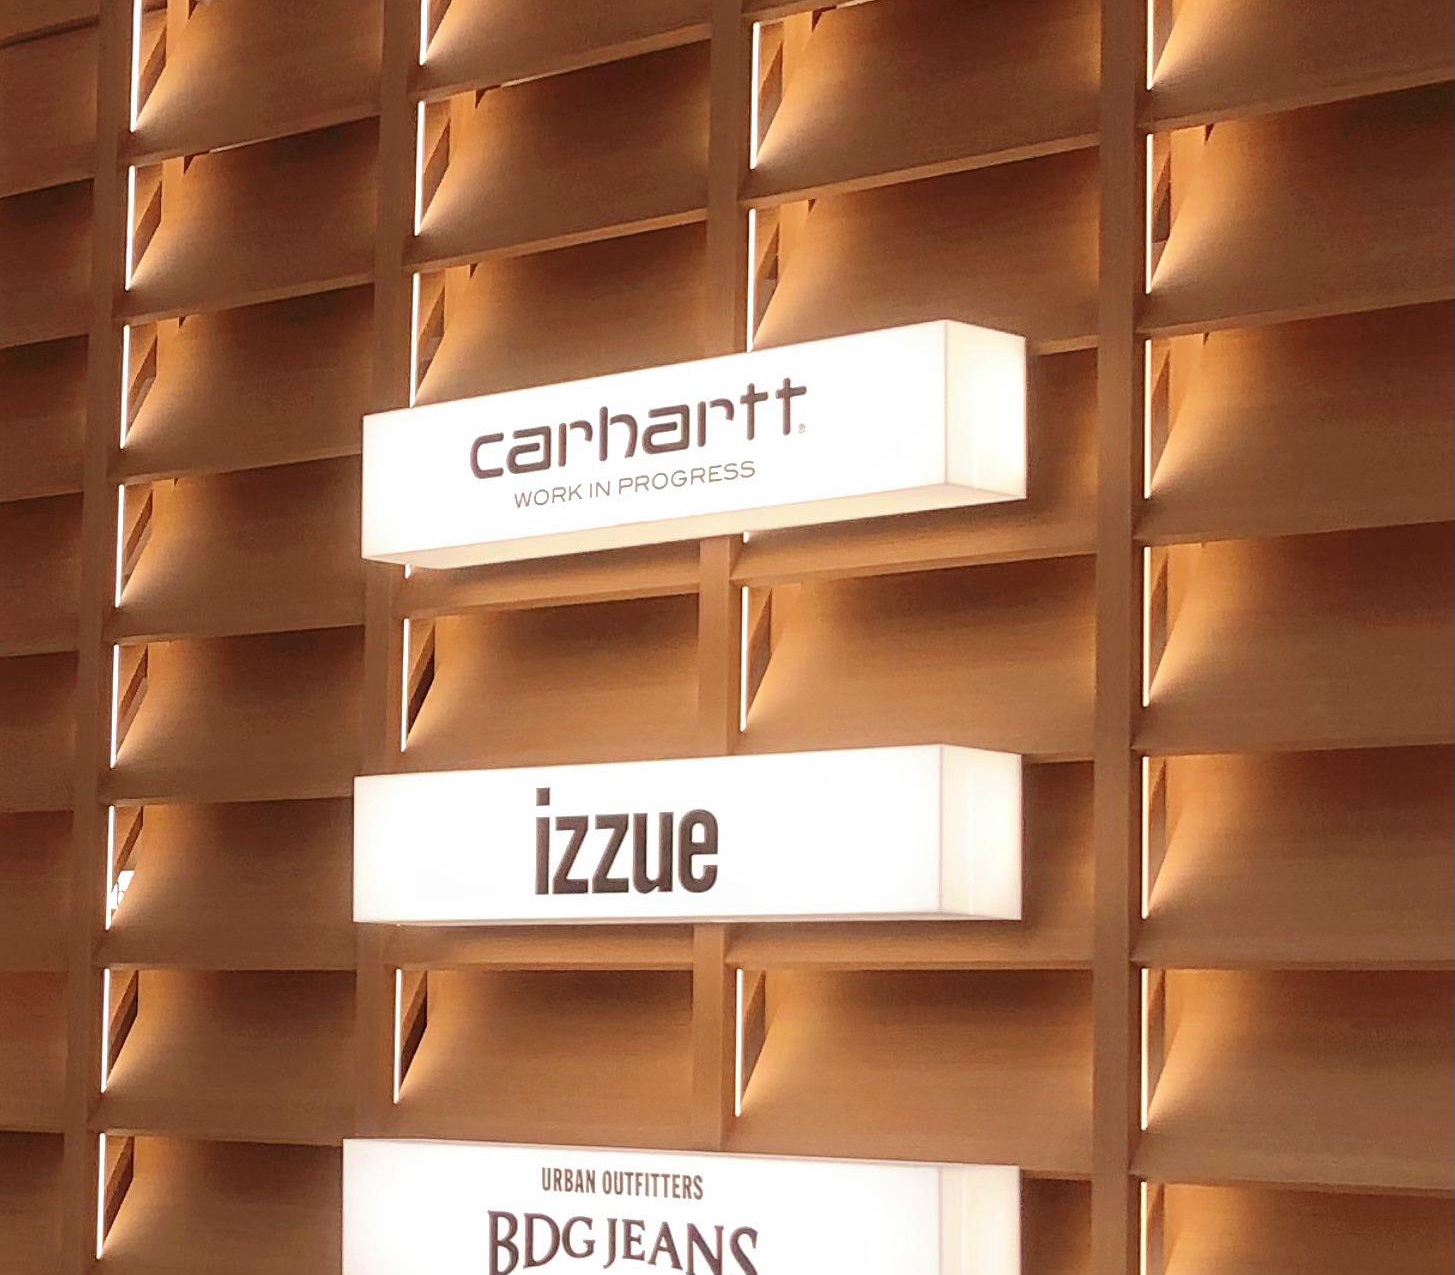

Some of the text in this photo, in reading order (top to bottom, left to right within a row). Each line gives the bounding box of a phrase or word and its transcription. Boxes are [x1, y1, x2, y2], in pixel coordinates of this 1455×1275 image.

[470, 377, 807, 479] carhartt
[514, 460, 756, 508] WORK IN PROGRESS
[535, 786, 719, 895] izzue
[541, 1166, 704, 1201] URBAN OUTFITTERS
